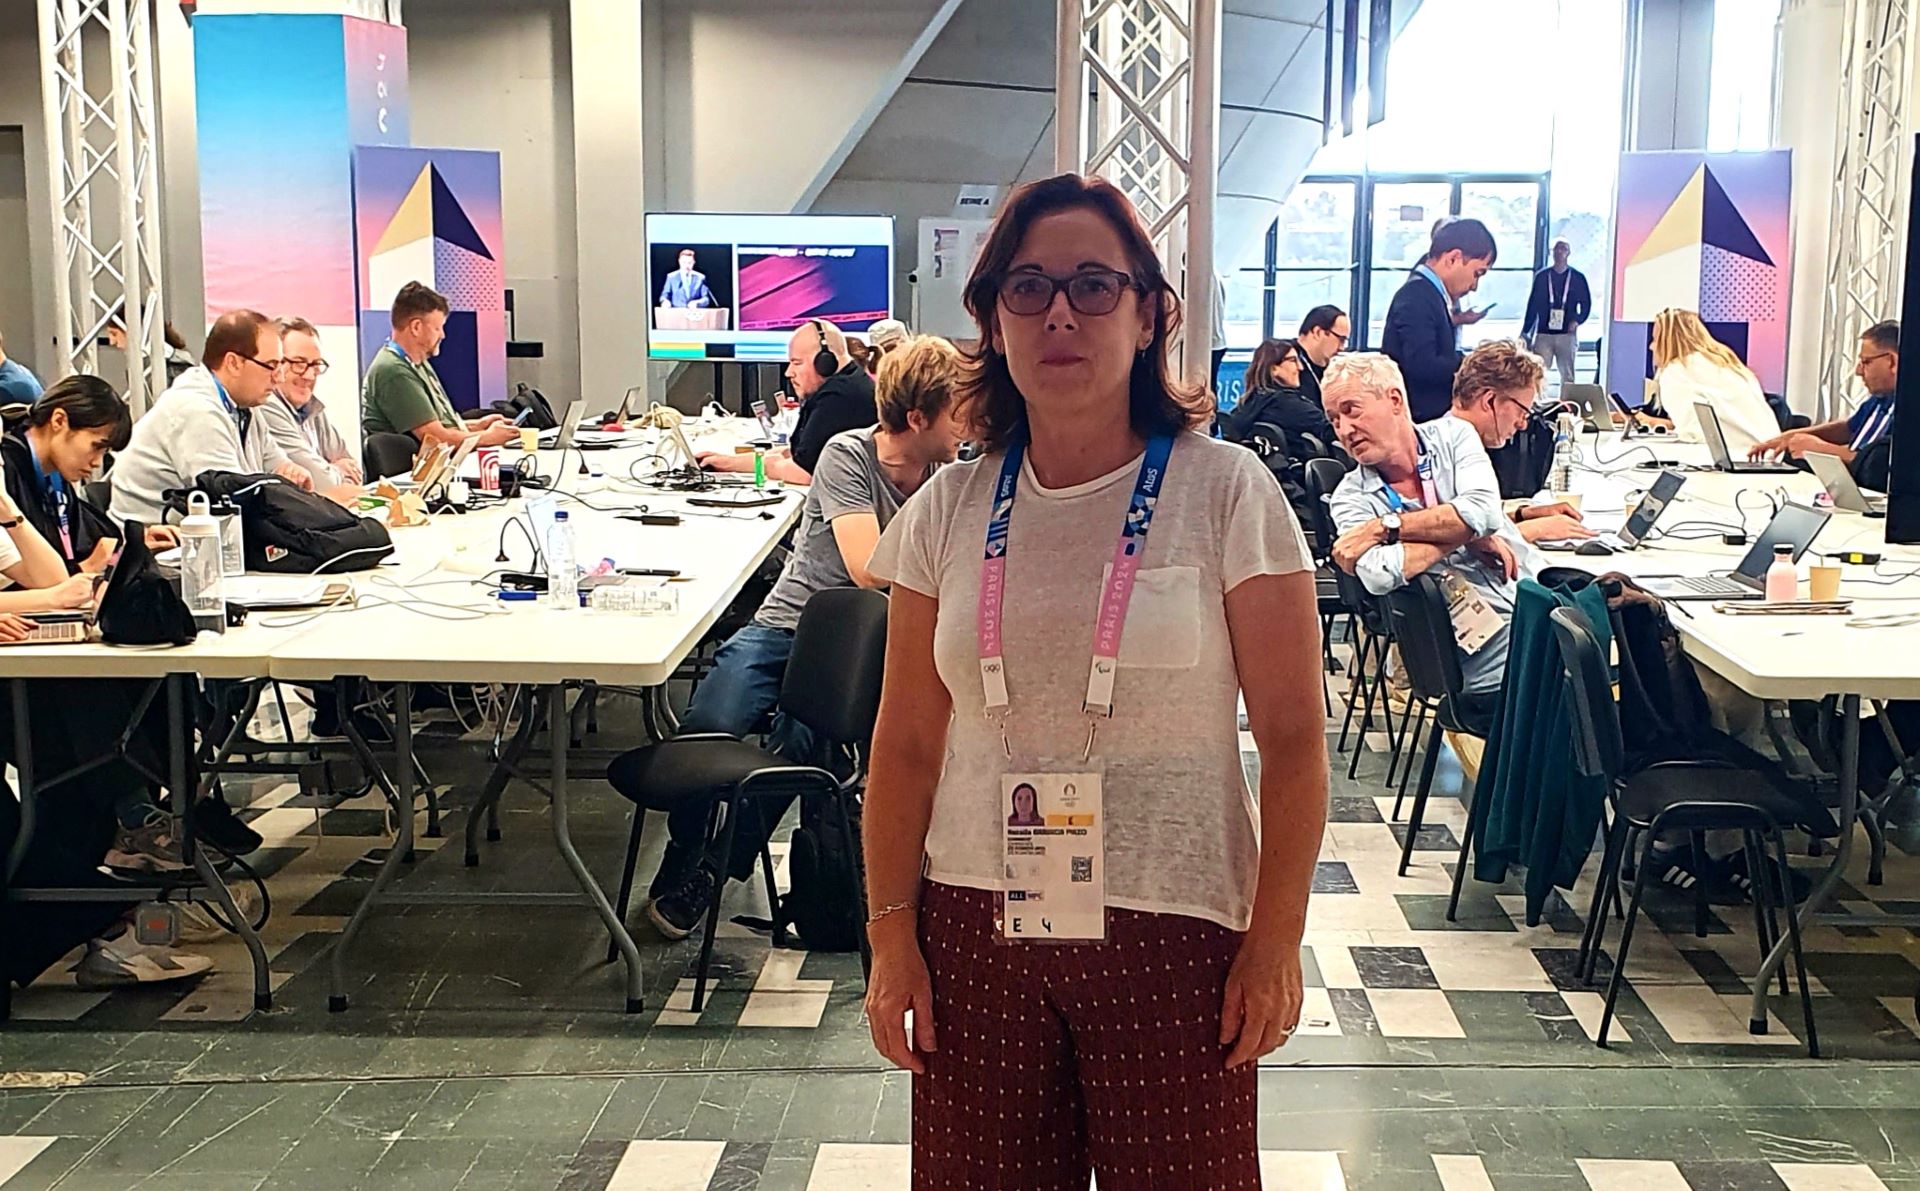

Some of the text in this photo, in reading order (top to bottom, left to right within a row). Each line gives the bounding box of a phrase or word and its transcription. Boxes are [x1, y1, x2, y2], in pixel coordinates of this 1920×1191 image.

[983, 565, 998, 651] PARIS 2024
[1100, 561, 1130, 650] PARIS 2024
[1012, 917, 1052, 933] E 4
